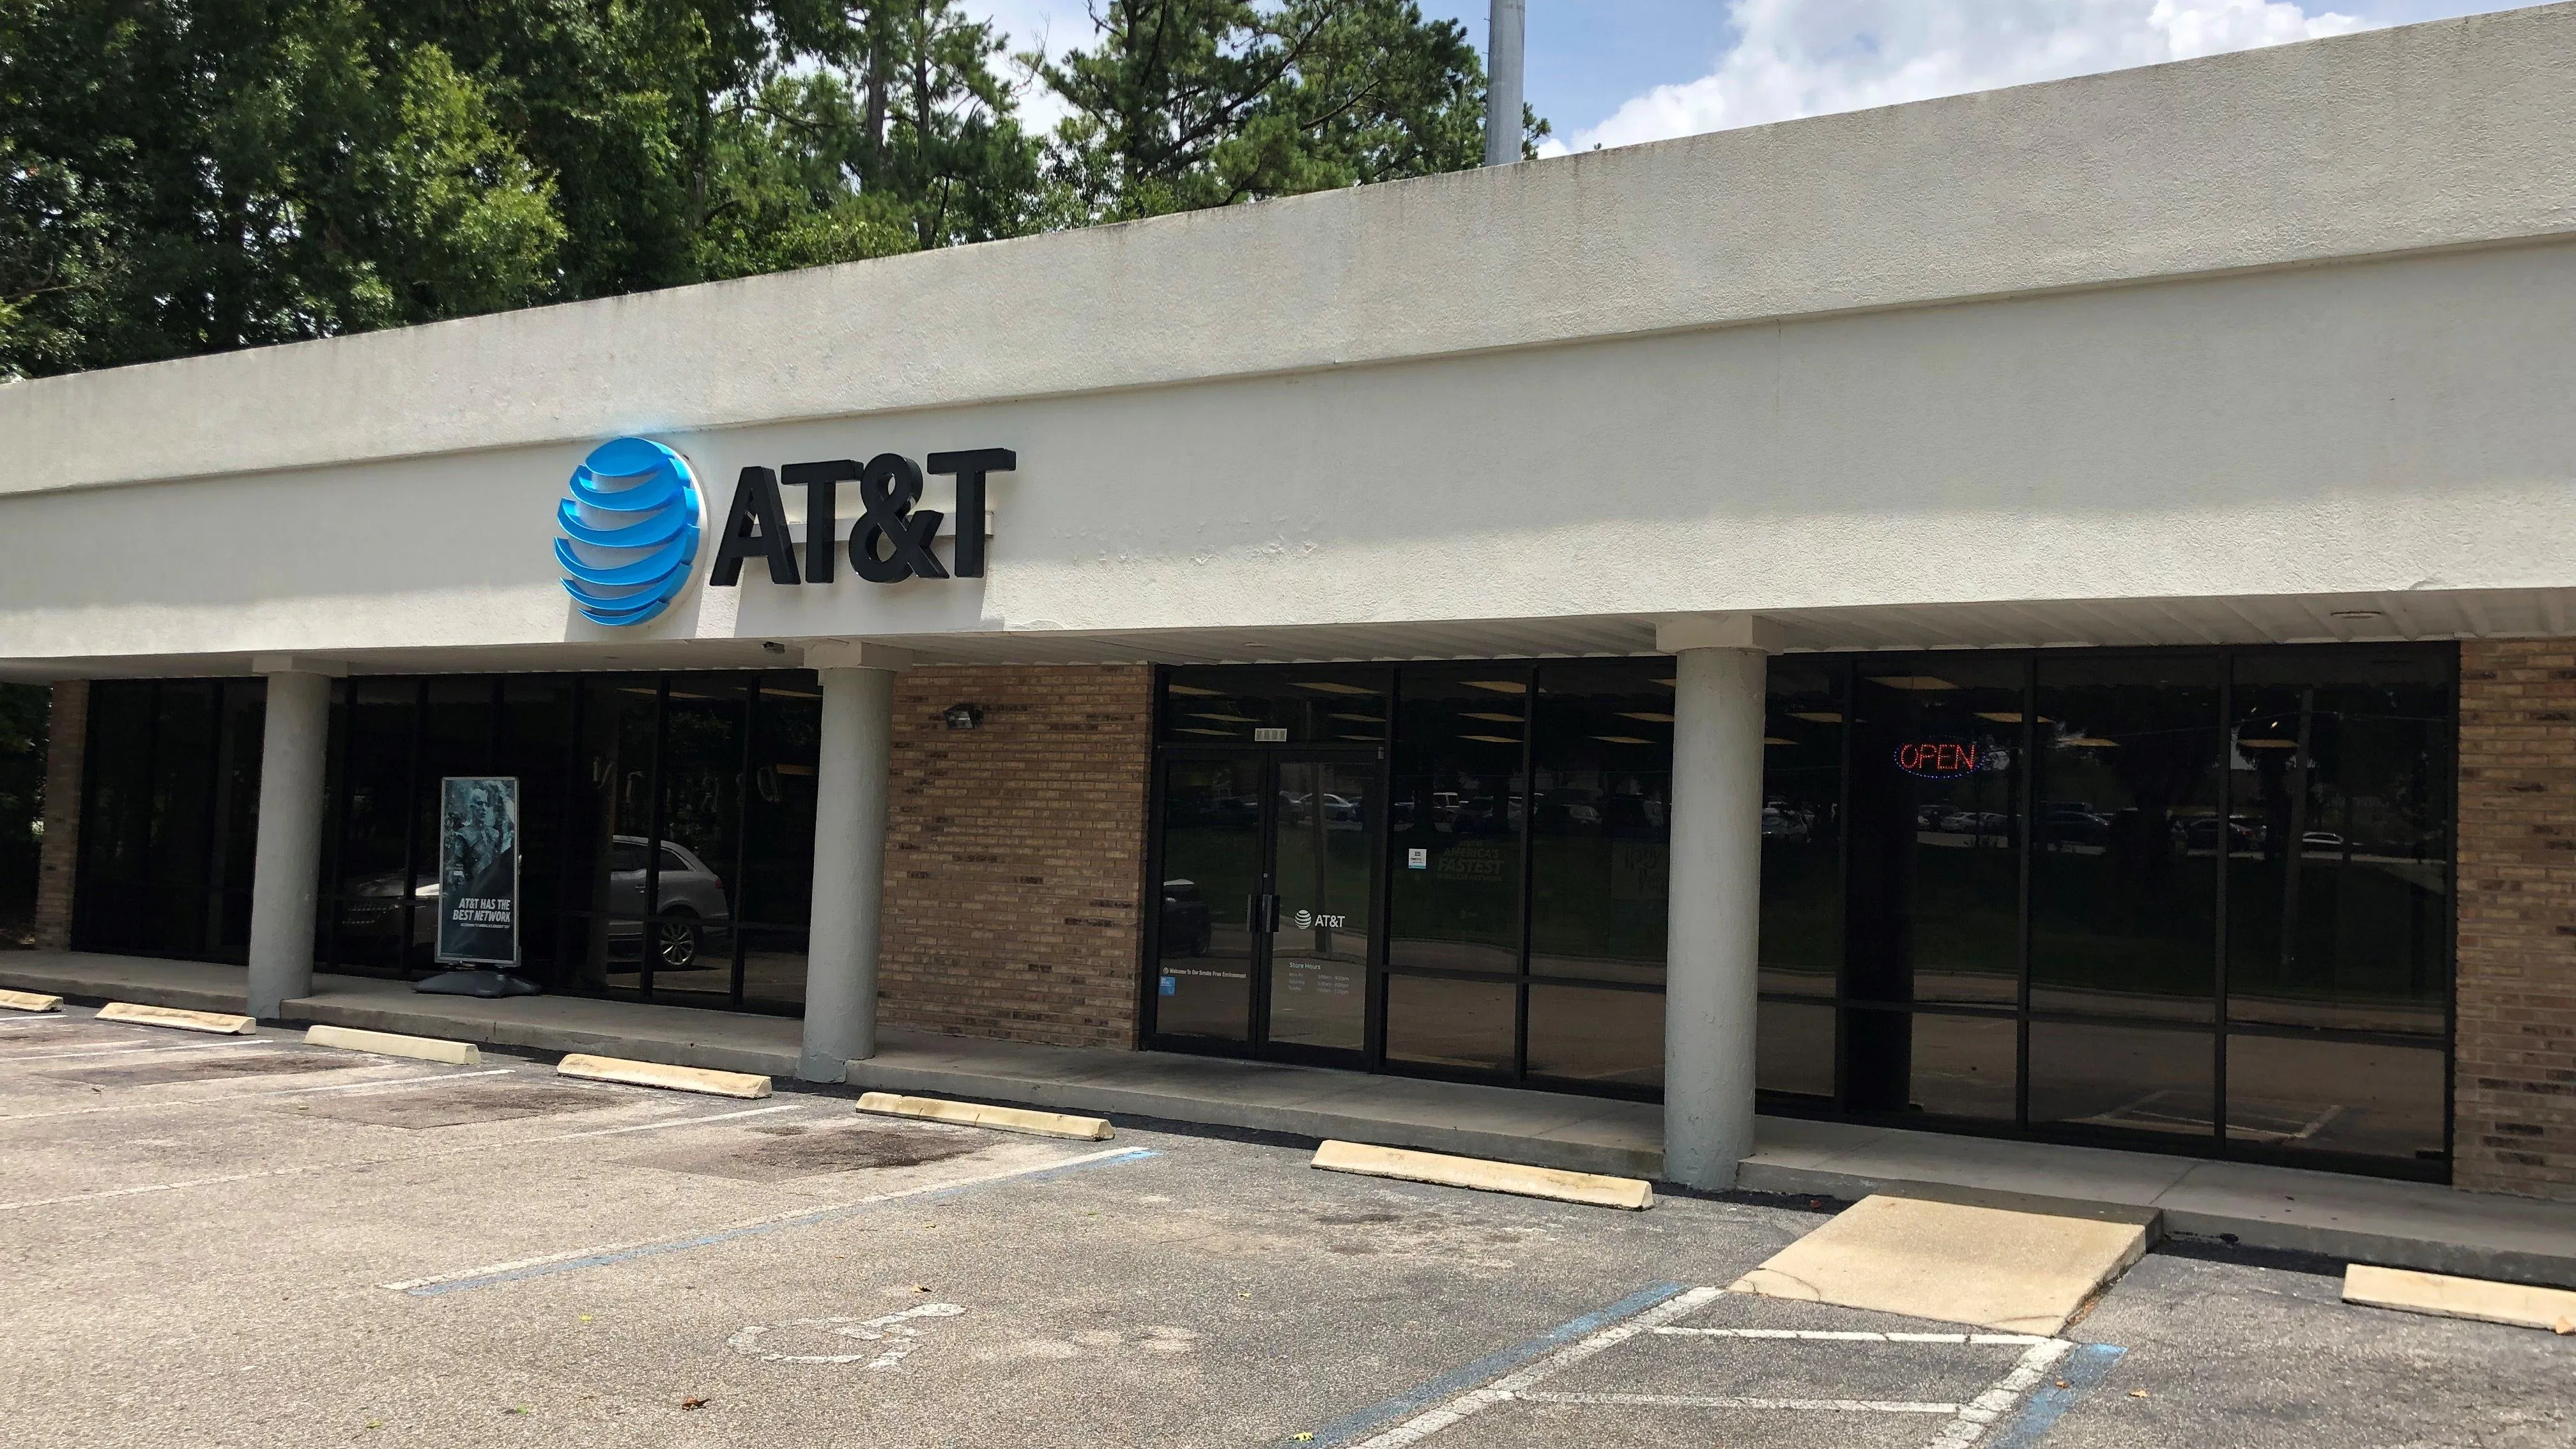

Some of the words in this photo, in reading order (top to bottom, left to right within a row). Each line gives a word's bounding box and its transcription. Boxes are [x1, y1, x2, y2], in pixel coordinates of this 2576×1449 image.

[709, 447, 1016, 586] AT&T
[1900, 744, 1976, 770] OPEN
[1443, 847, 1500, 859] AMERICA'S
[1437, 857, 1505, 874] FASTEST
[458, 898, 480, 909] AT&T
[480, 898, 496, 910] HAS
[497, 899, 511, 910] THE
[452, 909, 475, 921] BEST
[473, 910, 511, 923] NETWORK
[1314, 914, 1346, 928] AT&T
